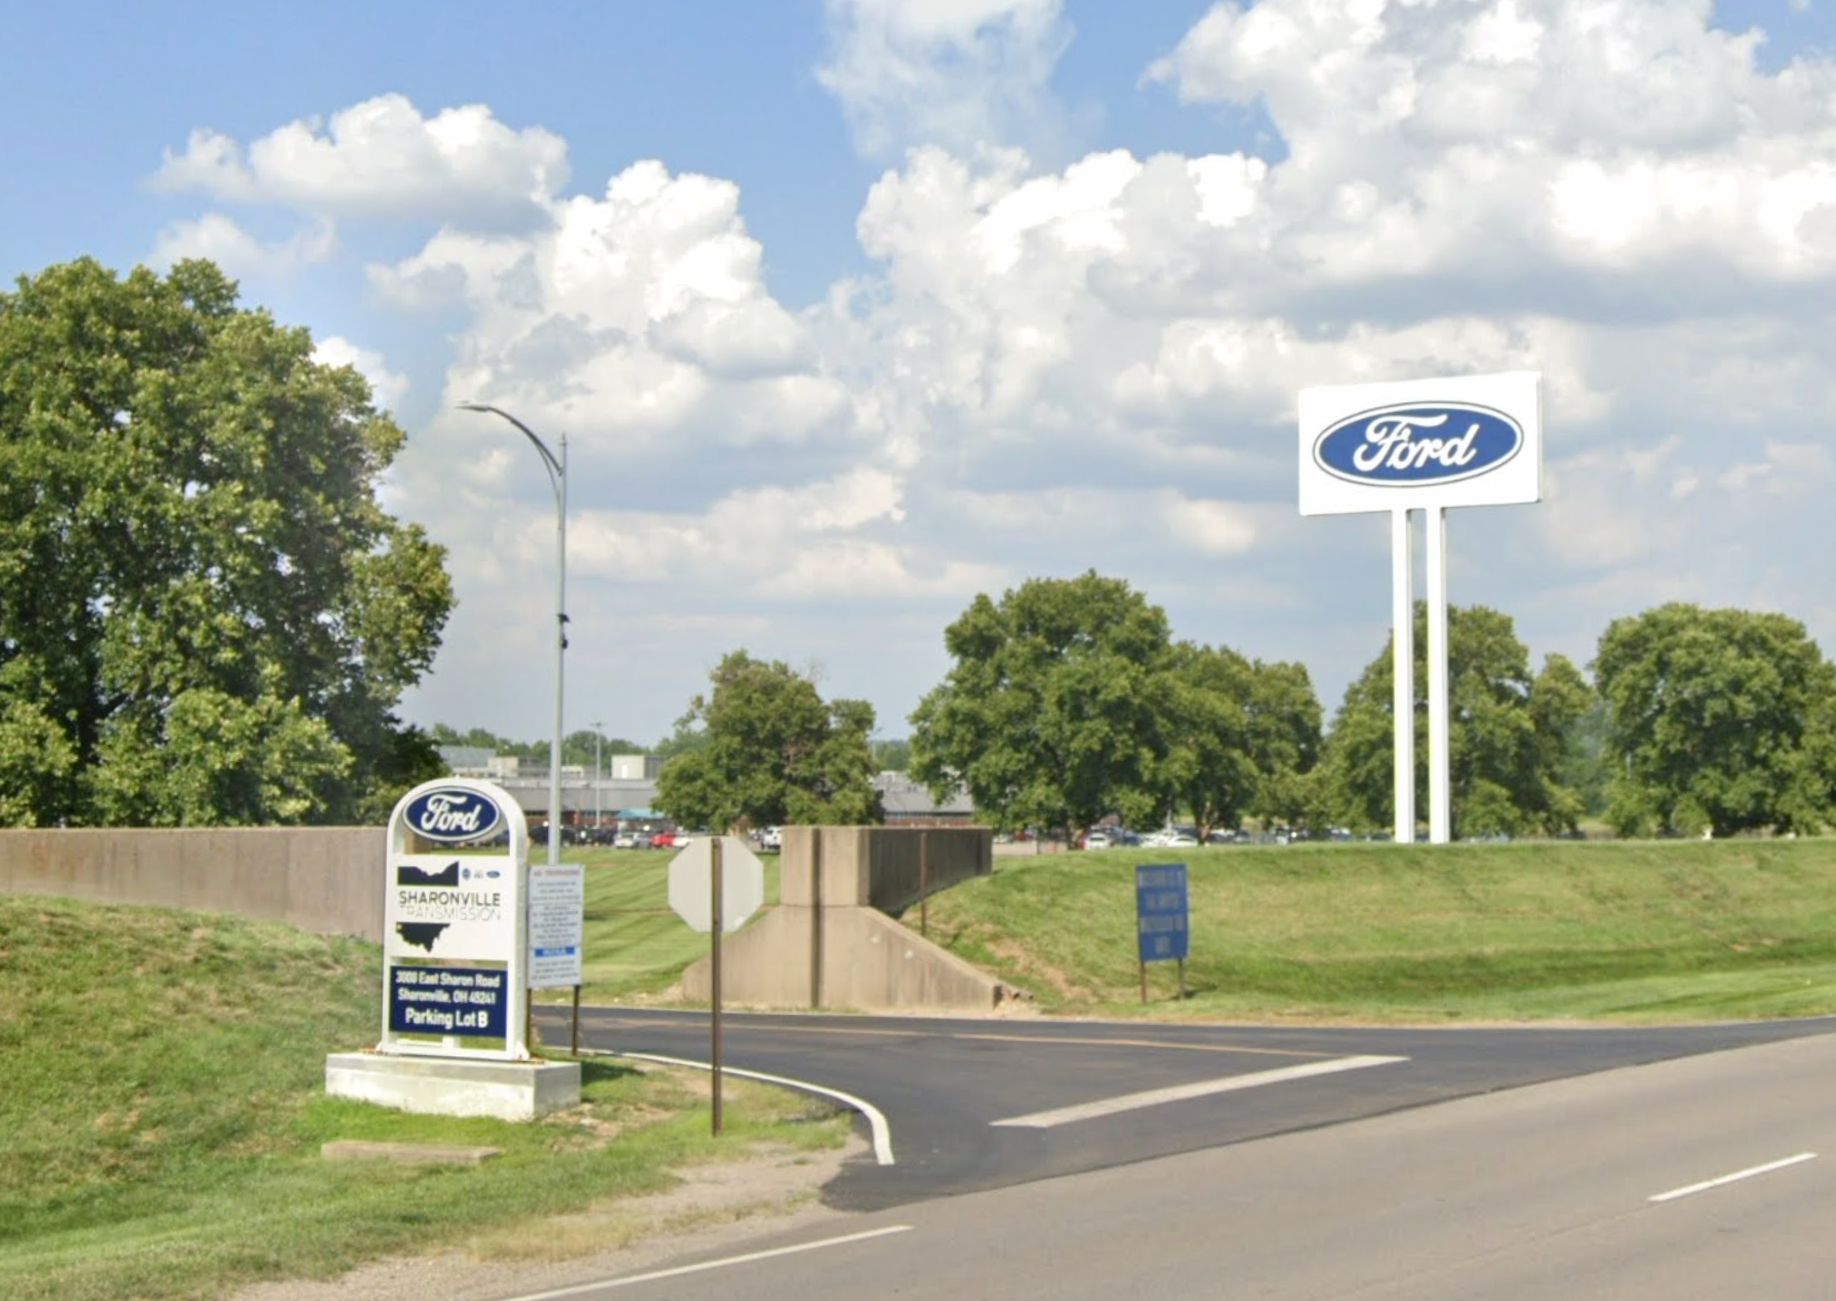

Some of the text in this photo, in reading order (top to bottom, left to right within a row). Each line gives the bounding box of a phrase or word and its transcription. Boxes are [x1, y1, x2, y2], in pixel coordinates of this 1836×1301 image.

[1353, 414, 1480, 472] Ford
[420, 794, 482, 832] Ford
[399, 890, 501, 907] SHARONVILLE
[399, 904, 501, 921] TRANSMISSION
[419, 972, 439, 985] East
[440, 972, 473, 986] Sharon
[475, 974, 500, 988] Road
[453, 990, 468, 1003] OH
[405, 1006, 488, 1030] Parking Lot B
